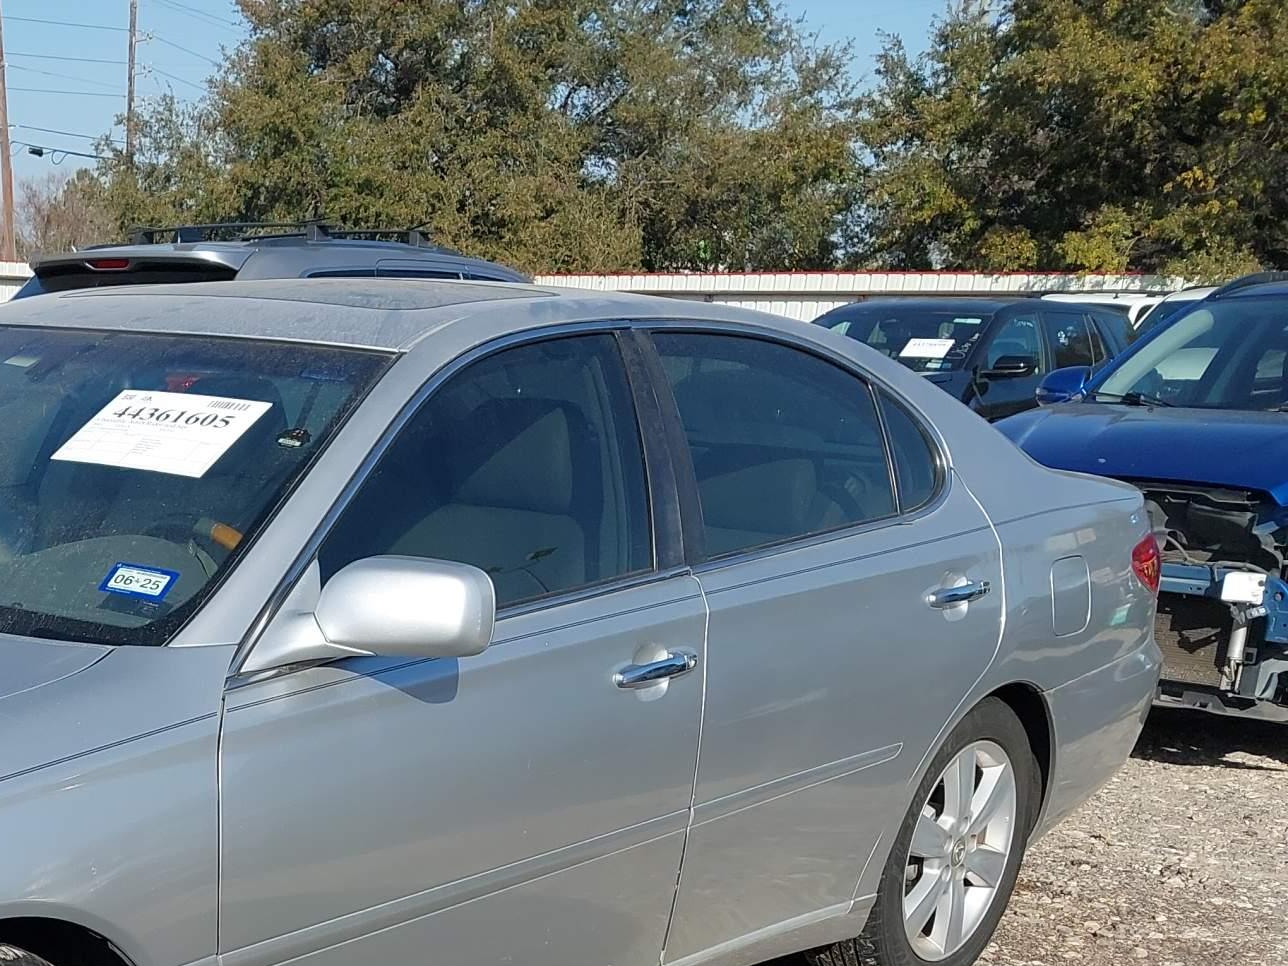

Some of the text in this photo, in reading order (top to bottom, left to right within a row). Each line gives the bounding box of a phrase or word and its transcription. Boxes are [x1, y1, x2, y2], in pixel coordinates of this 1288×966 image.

[113, 405, 236, 429] 44361605
[113, 574, 135, 586] 06
[139, 578, 162, 591] 25
